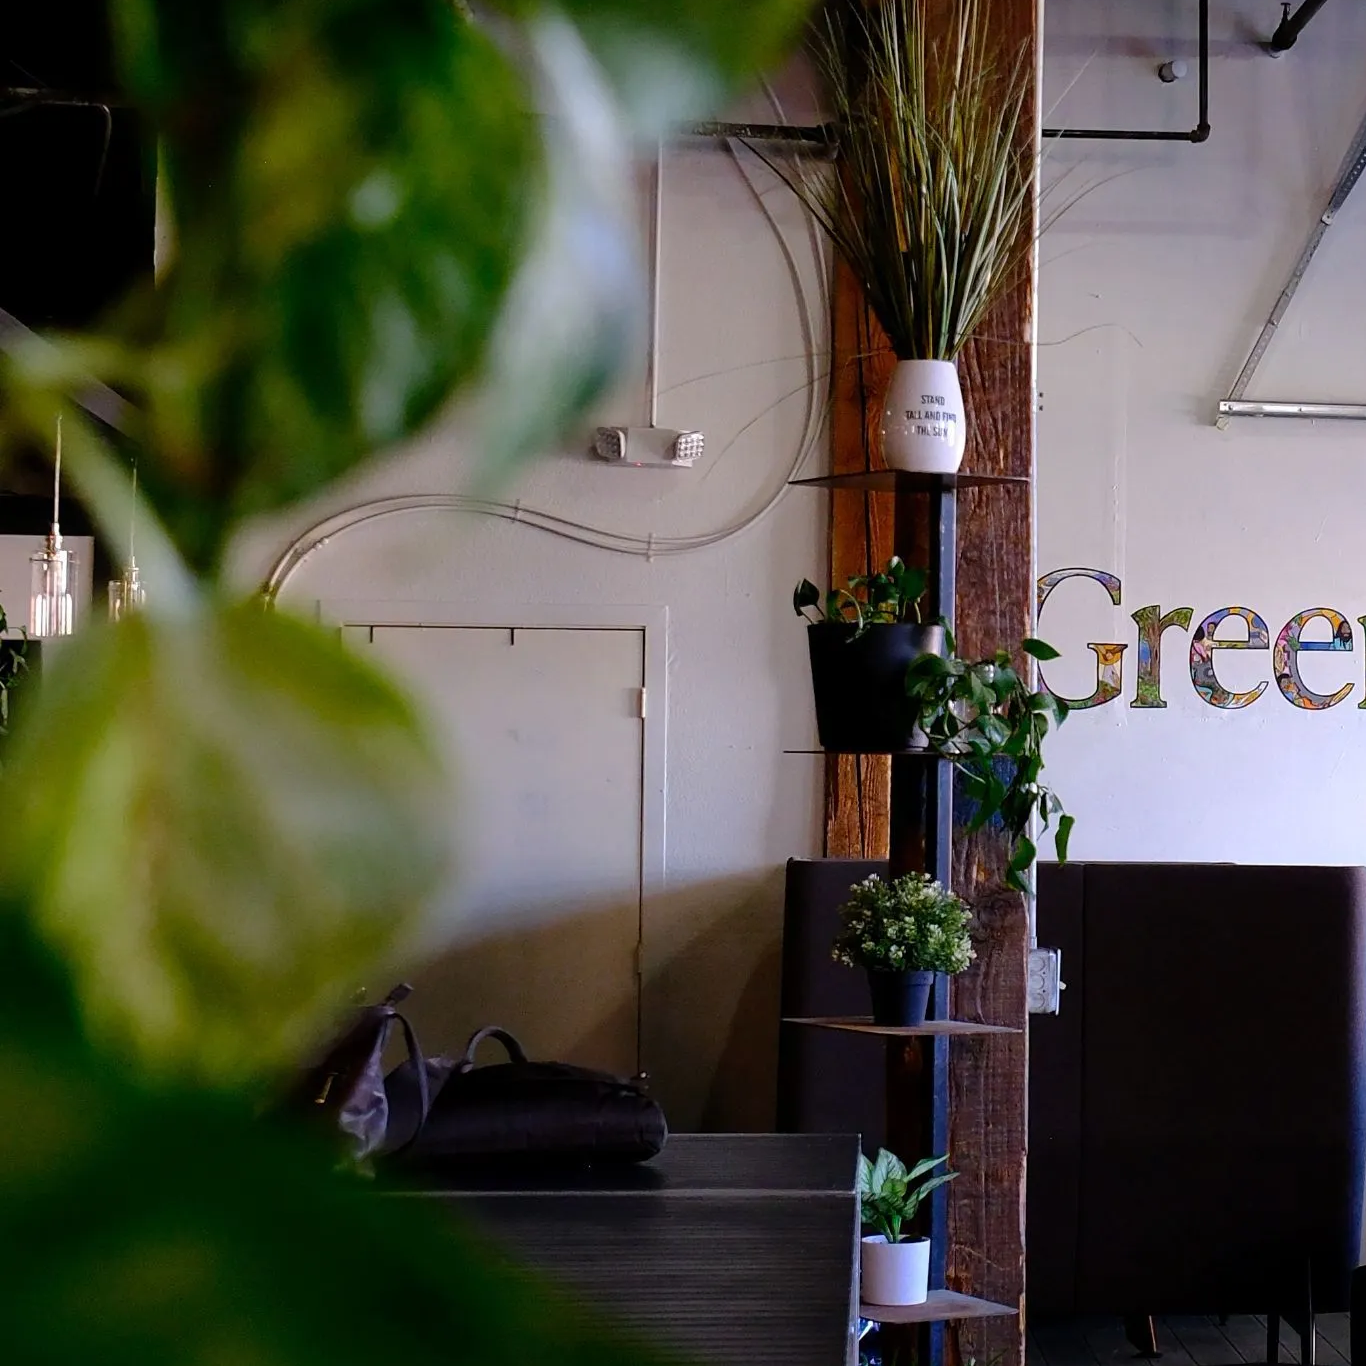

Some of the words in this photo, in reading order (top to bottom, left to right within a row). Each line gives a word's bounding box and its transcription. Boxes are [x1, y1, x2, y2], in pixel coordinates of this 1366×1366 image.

[921, 395, 945, 406] STAND
[905, 410, 923, 421] TALL
[924, 411, 941, 421] AND
